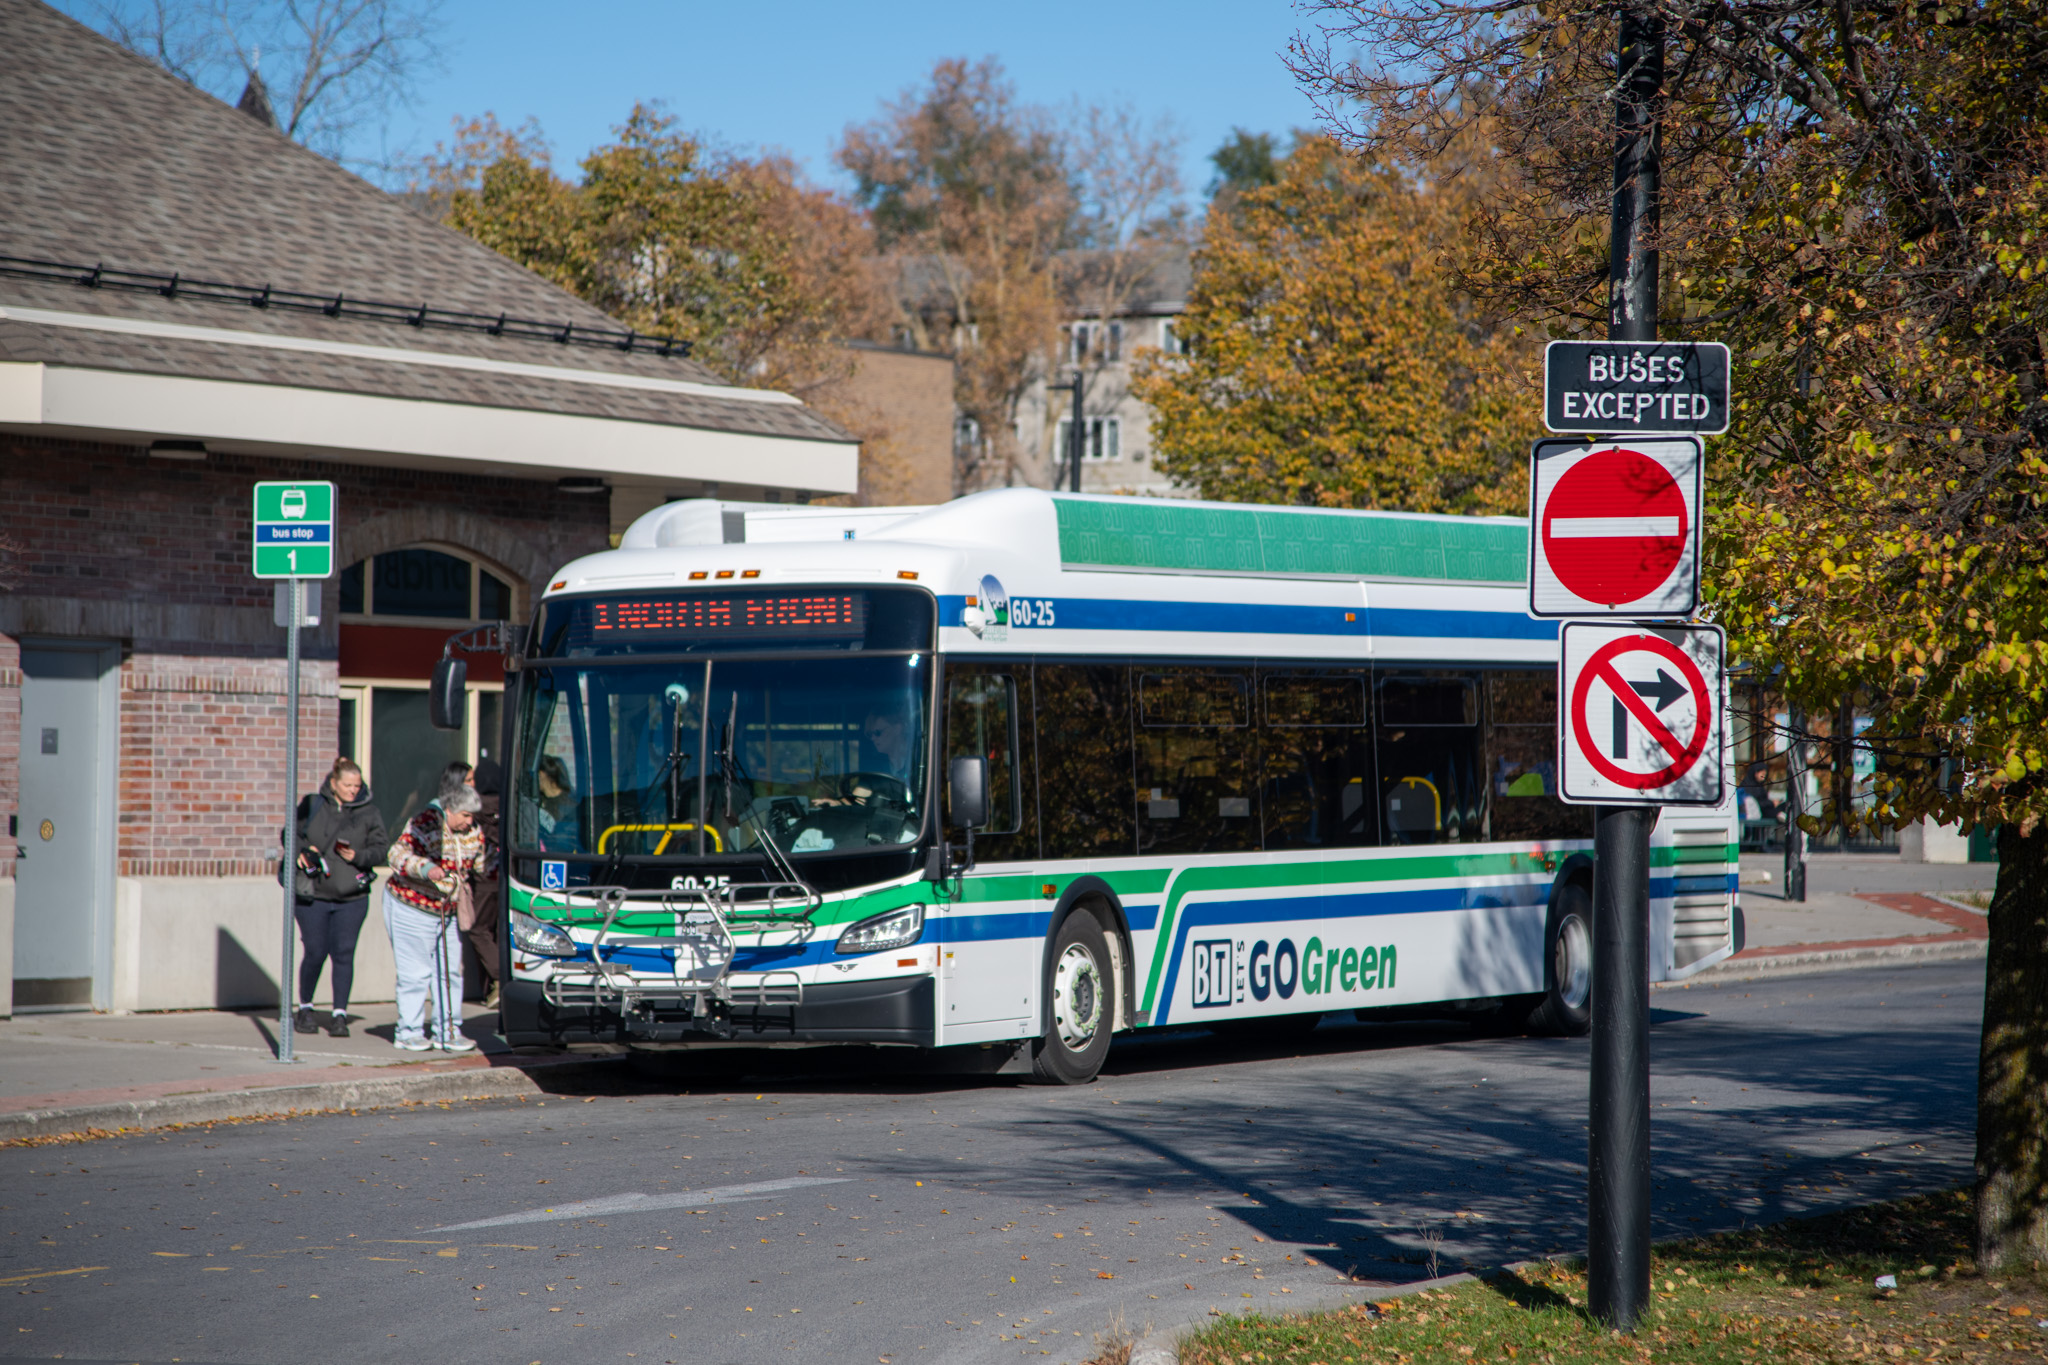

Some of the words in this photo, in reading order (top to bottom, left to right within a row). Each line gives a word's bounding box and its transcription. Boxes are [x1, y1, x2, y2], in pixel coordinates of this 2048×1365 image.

[1589, 353, 1685, 382] BUSES
[1563, 391, 1710, 421] EXCEPTED
[272, 527, 290, 538] bus
[292, 527, 314, 540] stop
[287, 549, 296, 571] 1
[1012, 599, 1055, 626] 60-25
[671, 876, 731, 895] 60-25
[1193, 940, 1232, 1007] BT
[1236, 940, 1245, 1003] LET'S
